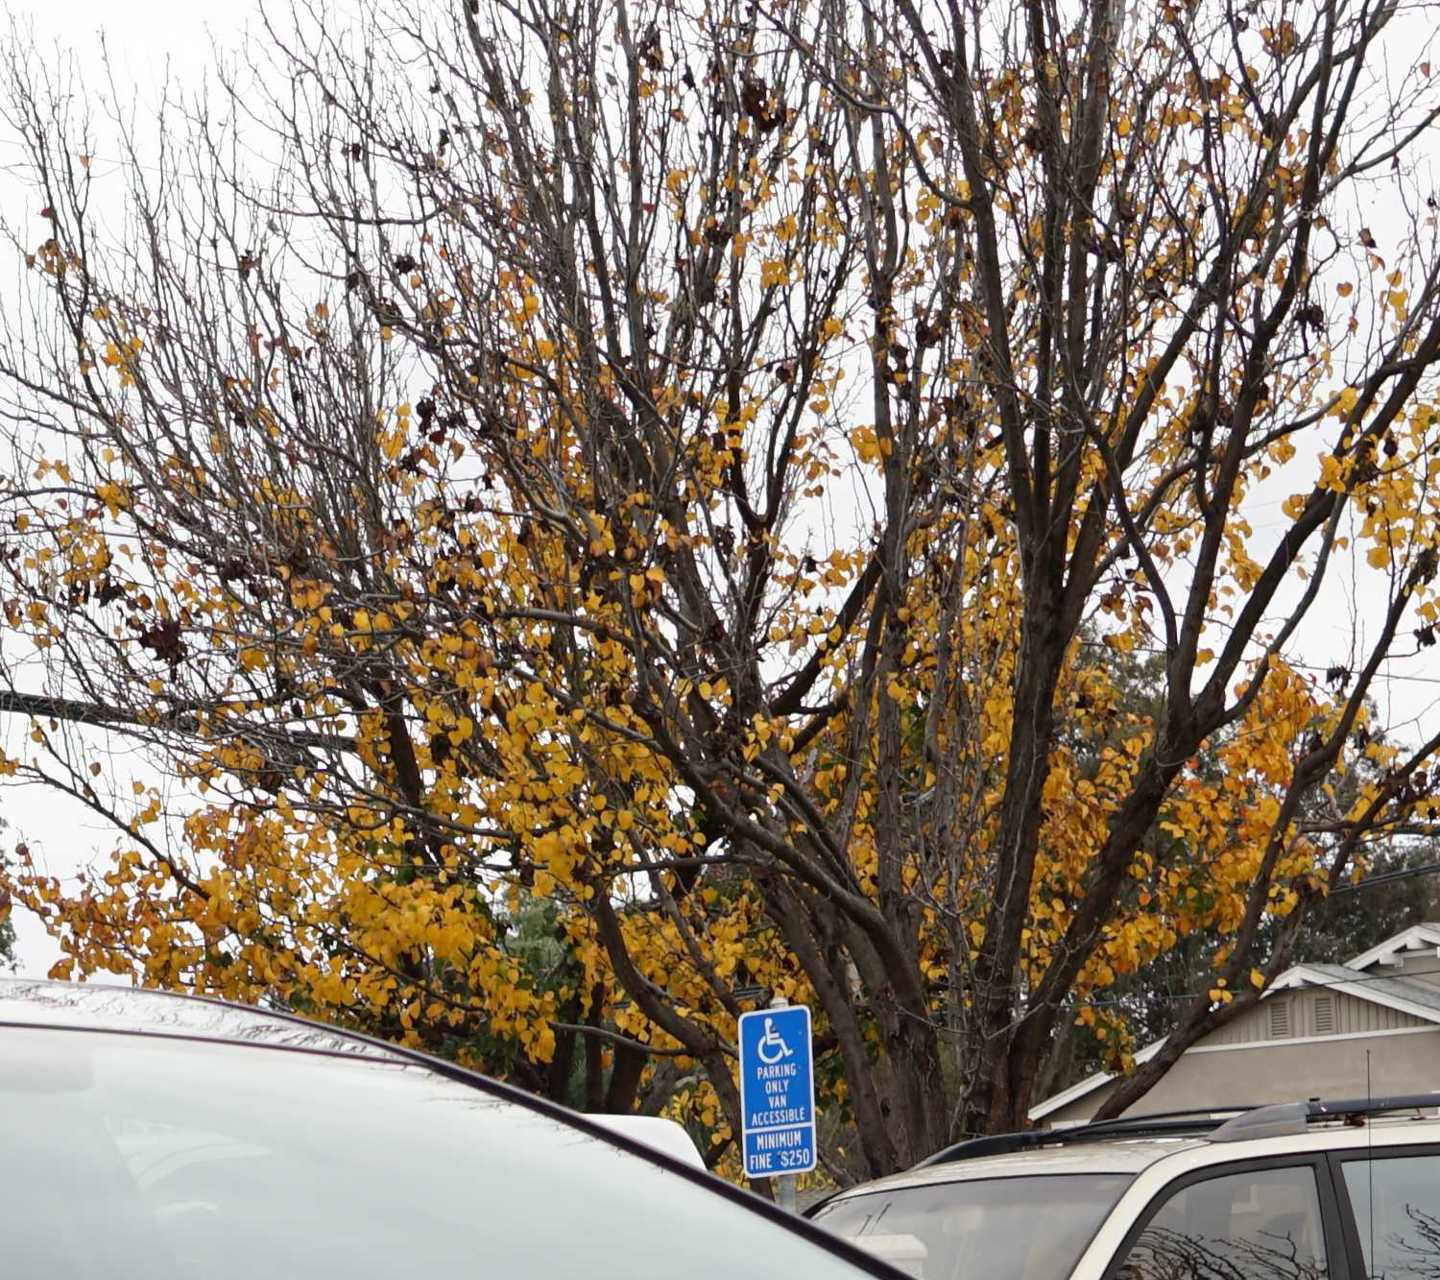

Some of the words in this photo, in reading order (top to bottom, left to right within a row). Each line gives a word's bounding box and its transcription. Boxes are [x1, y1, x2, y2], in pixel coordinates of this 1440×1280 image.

[757, 1063, 796, 1080] PARKING
[765, 1080, 789, 1094] ONLY
[768, 1095, 787, 1108] VAN
[751, 1107, 805, 1126] ACCESSIBLE
[756, 1131, 801, 1150] MINIMUM
[750, 1153, 772, 1170] FINE
[780, 1148, 810, 1168] $250
